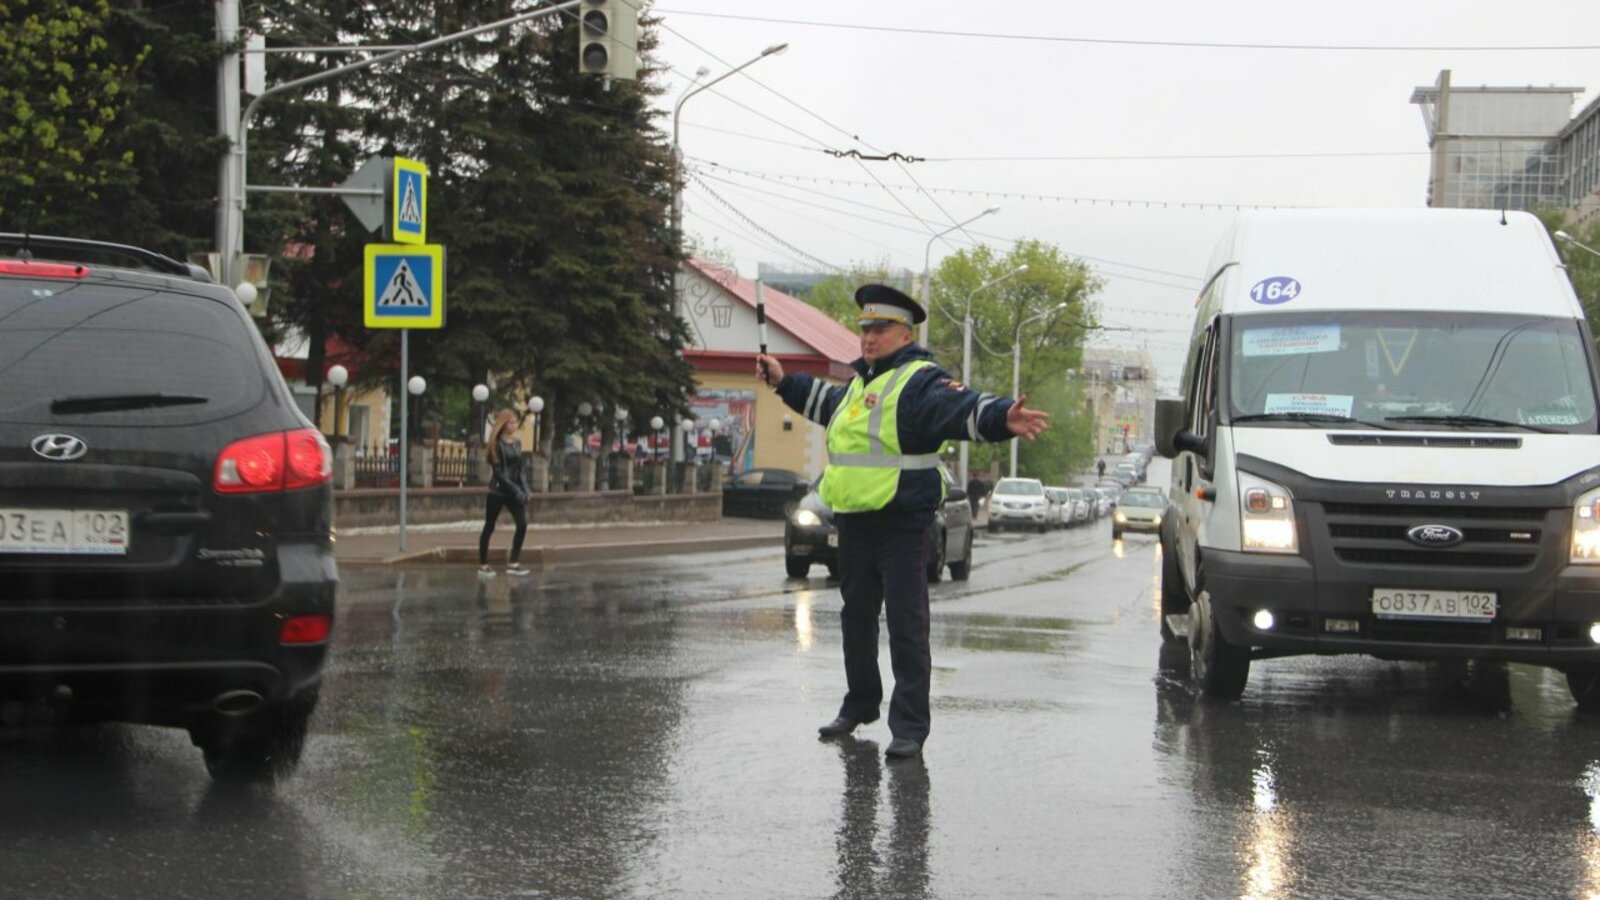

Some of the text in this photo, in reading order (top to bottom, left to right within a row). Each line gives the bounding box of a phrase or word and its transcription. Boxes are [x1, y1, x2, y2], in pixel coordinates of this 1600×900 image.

[1252, 281, 1298, 301] 164
[1386, 490, 1480, 499] TRANSIT
[1420, 526, 1451, 540] Ford
[1462, 595, 1491, 610] 102
